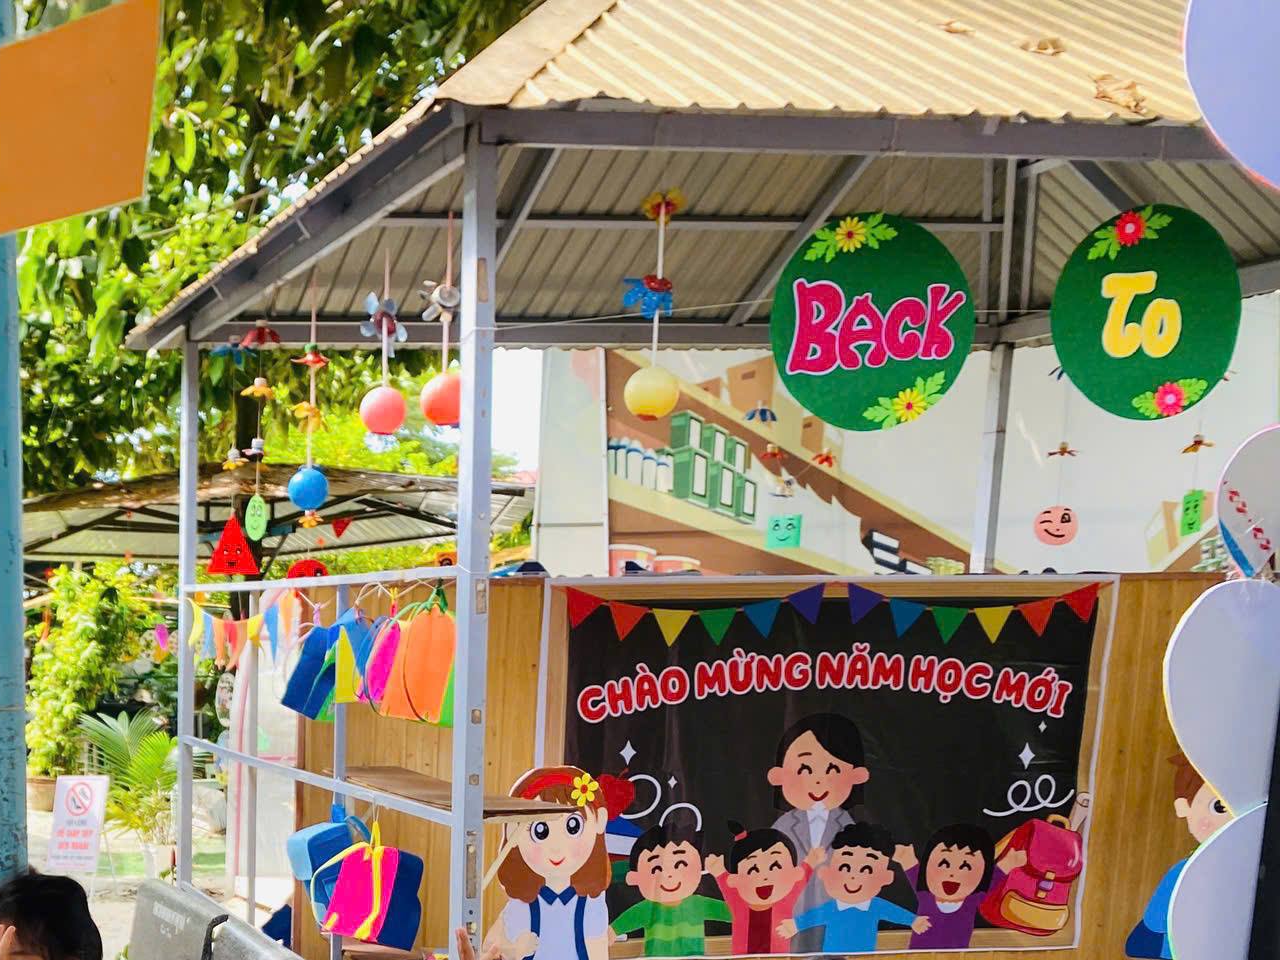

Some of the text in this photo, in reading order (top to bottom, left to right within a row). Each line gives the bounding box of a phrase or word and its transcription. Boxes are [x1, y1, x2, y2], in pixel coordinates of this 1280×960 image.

[786, 279, 966, 375] BACK
[578, 642, 1072, 723] CHÀO MỪNG NĂM HỌC MỚI
